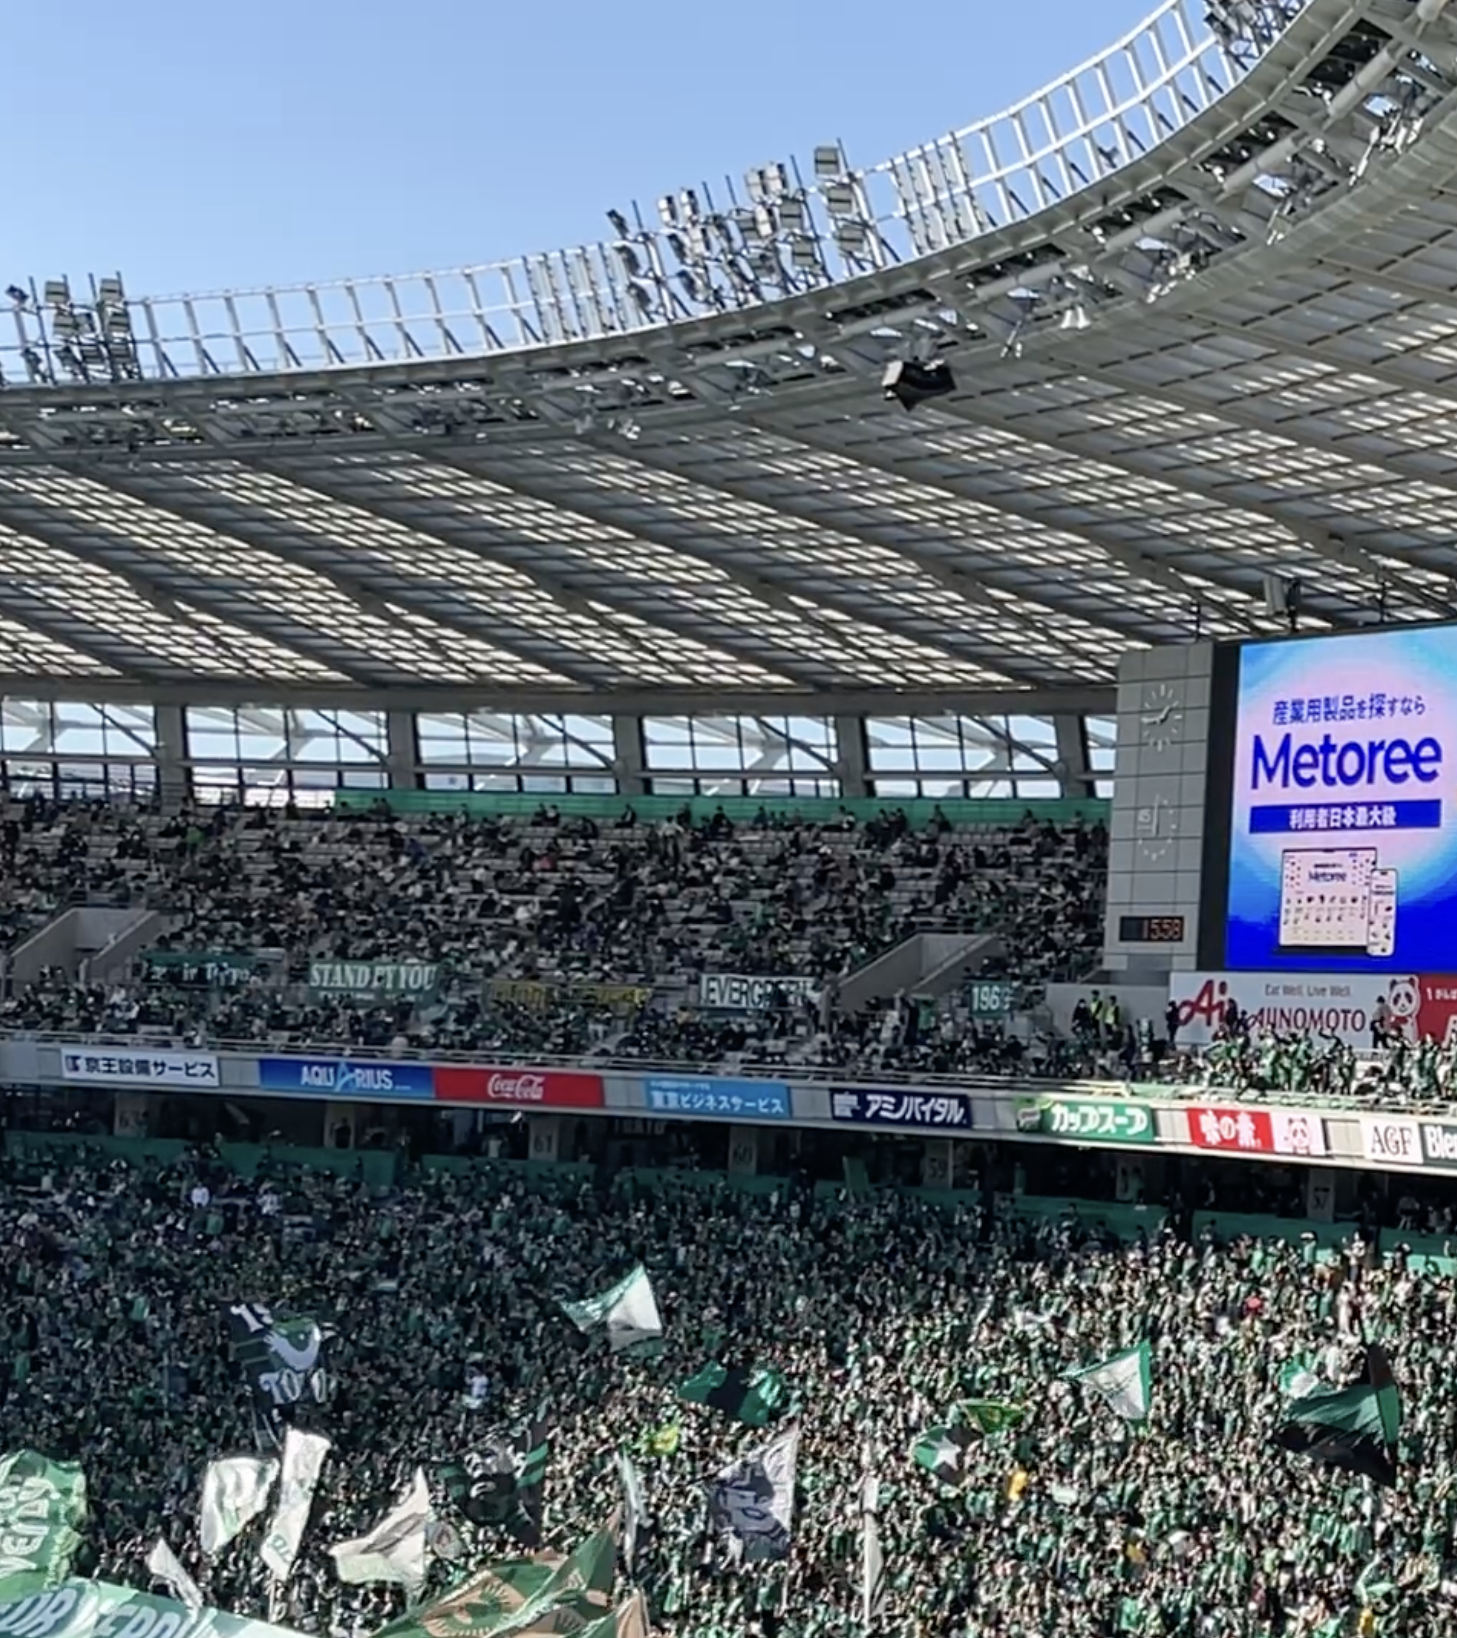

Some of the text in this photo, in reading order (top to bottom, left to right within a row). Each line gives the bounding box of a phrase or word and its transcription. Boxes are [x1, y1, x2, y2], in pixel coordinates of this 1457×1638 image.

[1273, 693, 1426, 726] 産業用製品を探すなら
[1250, 733, 1443, 790] Metoree
[1289, 806, 1397, 830] 利用者日本最大級
[310, 963, 371, 987] STAND
[399, 965, 438, 991] YOU
[84, 1056, 216, 1079] 京王設備サービス
[300, 1062, 394, 1091] AQUARIUS
[865, 1094, 965, 1124] アミノバイタル
[1051, 1103, 1148, 1135] カップスープ
[1199, 1110, 1257, 1146] 味の素
[1371, 1125, 1412, 1156] AGF
